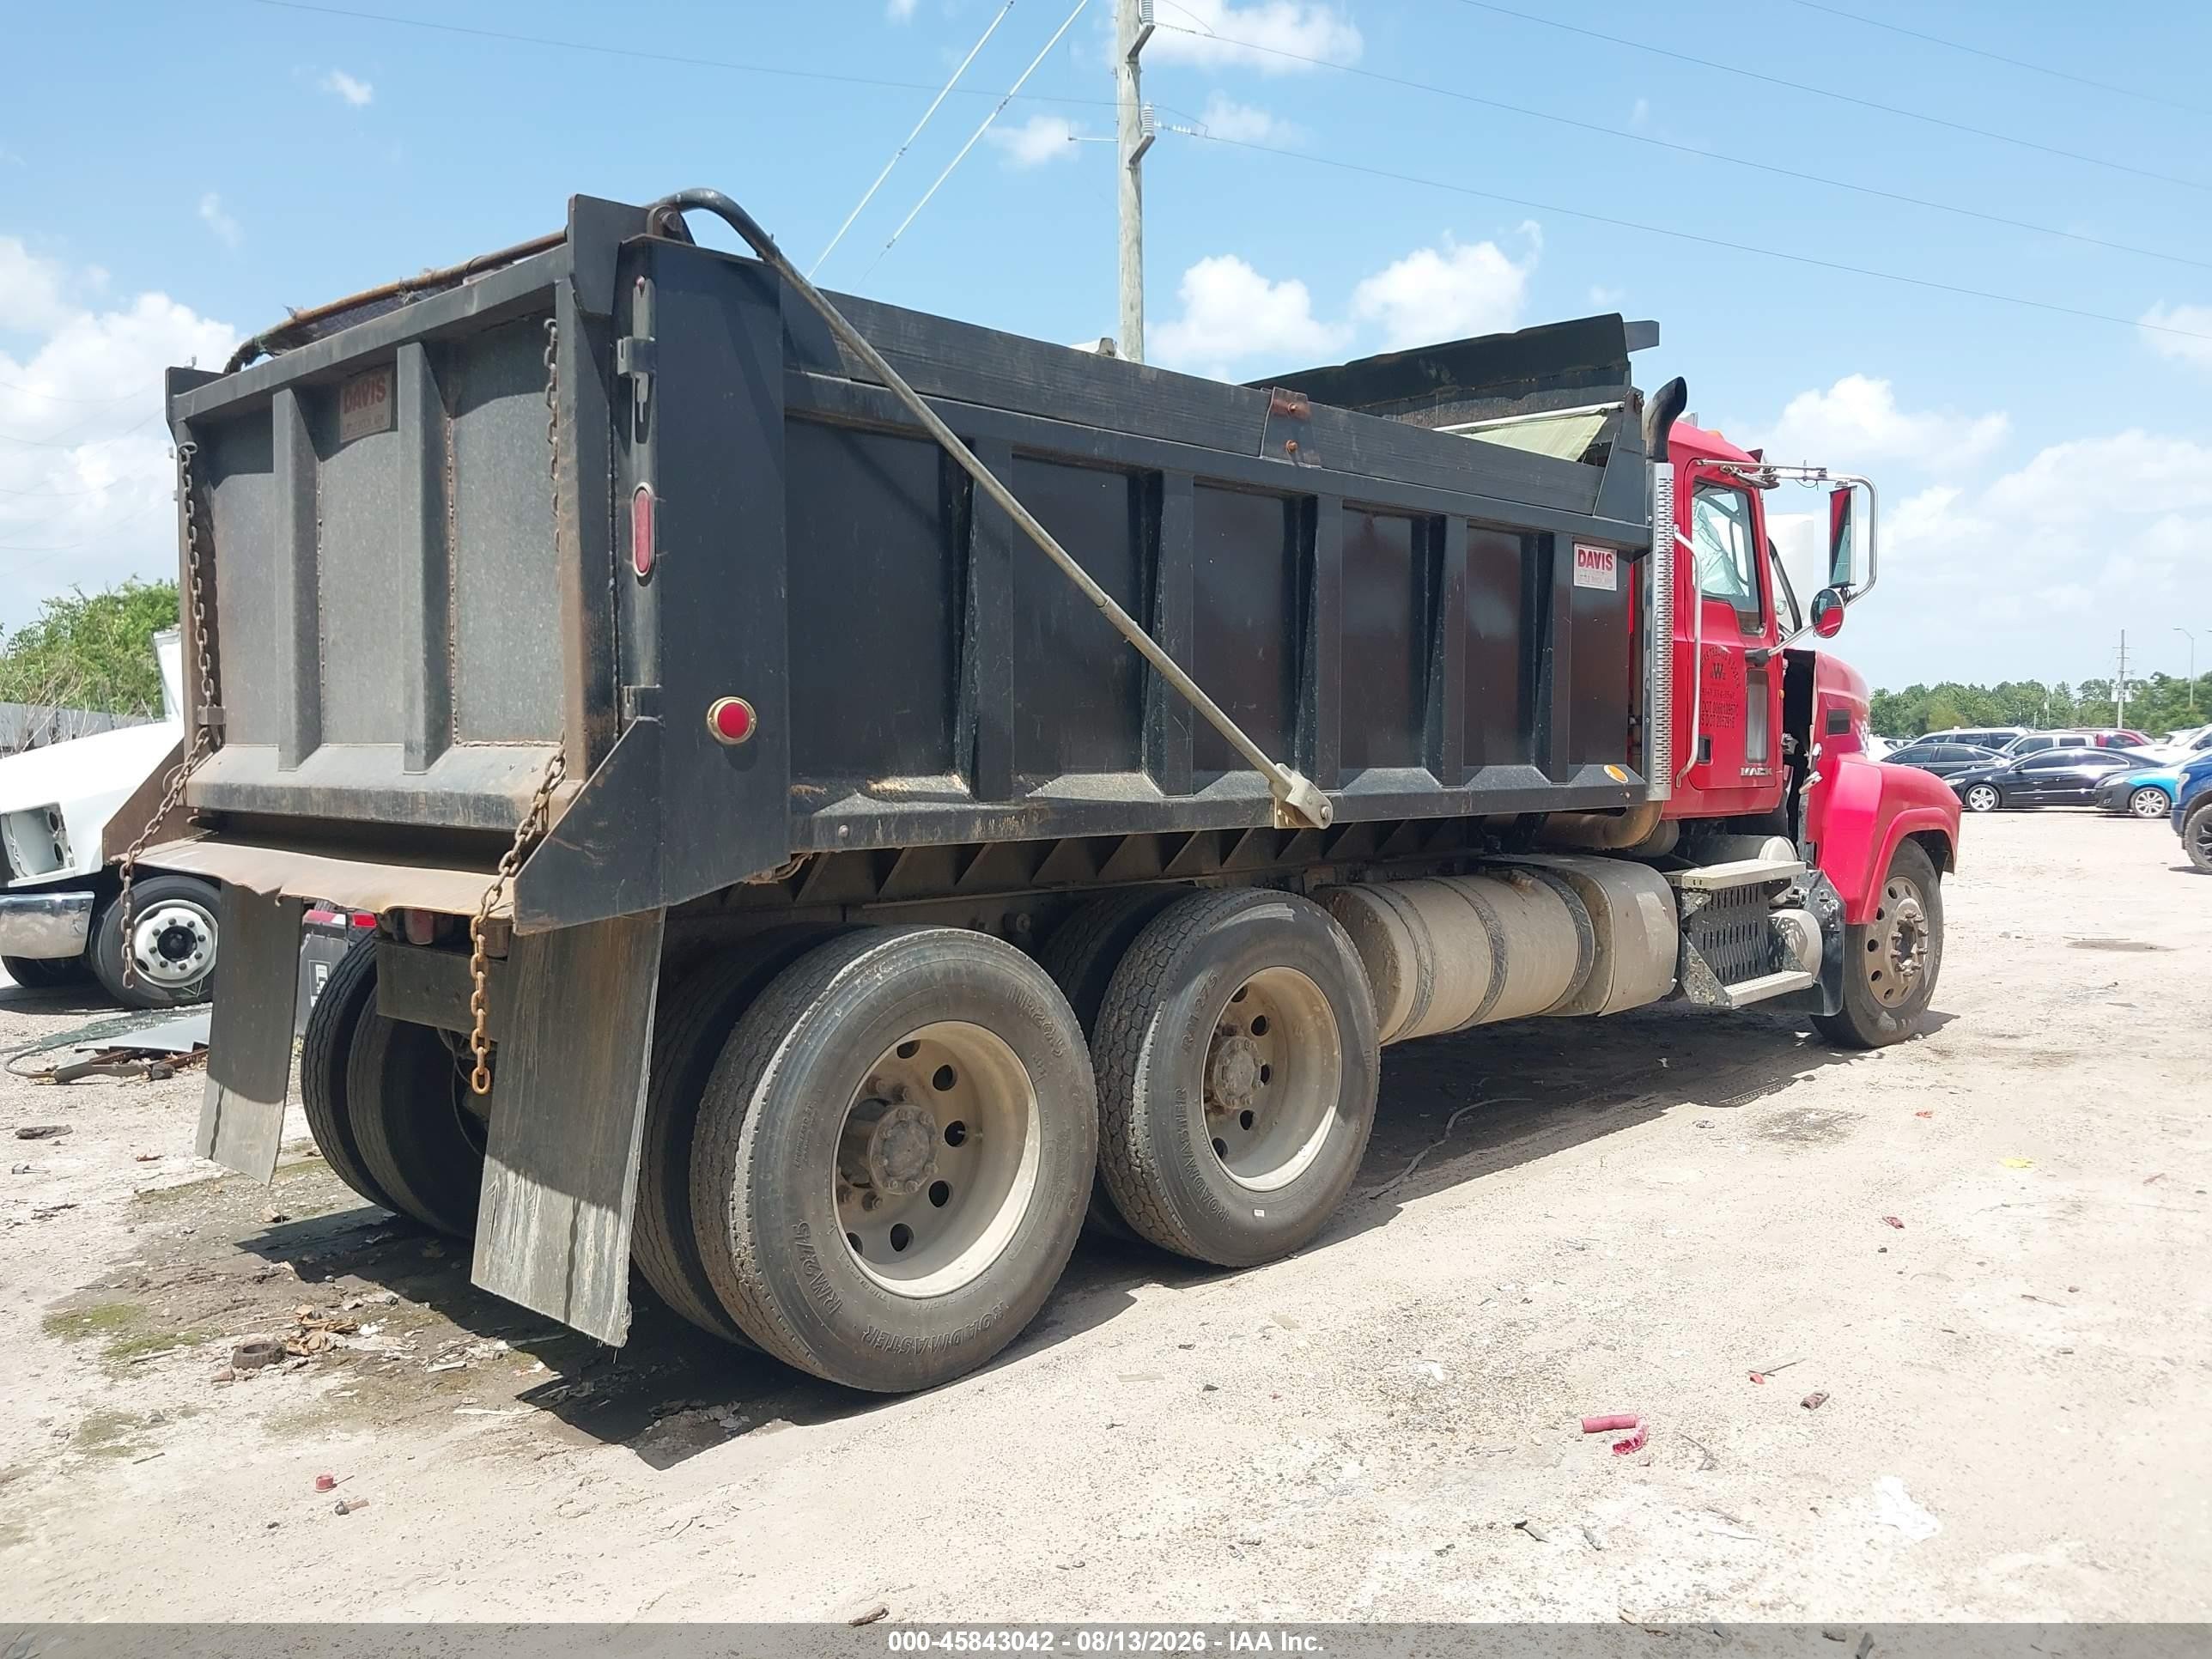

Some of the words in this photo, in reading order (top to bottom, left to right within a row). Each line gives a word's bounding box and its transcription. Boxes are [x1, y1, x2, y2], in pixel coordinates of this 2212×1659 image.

[343, 375, 386, 414] DAVIS
[1577, 549, 1613, 572] DAVIS
[1739, 767, 1773, 776] MACK
[861, 1301, 1005, 1355] ROADMASTER
